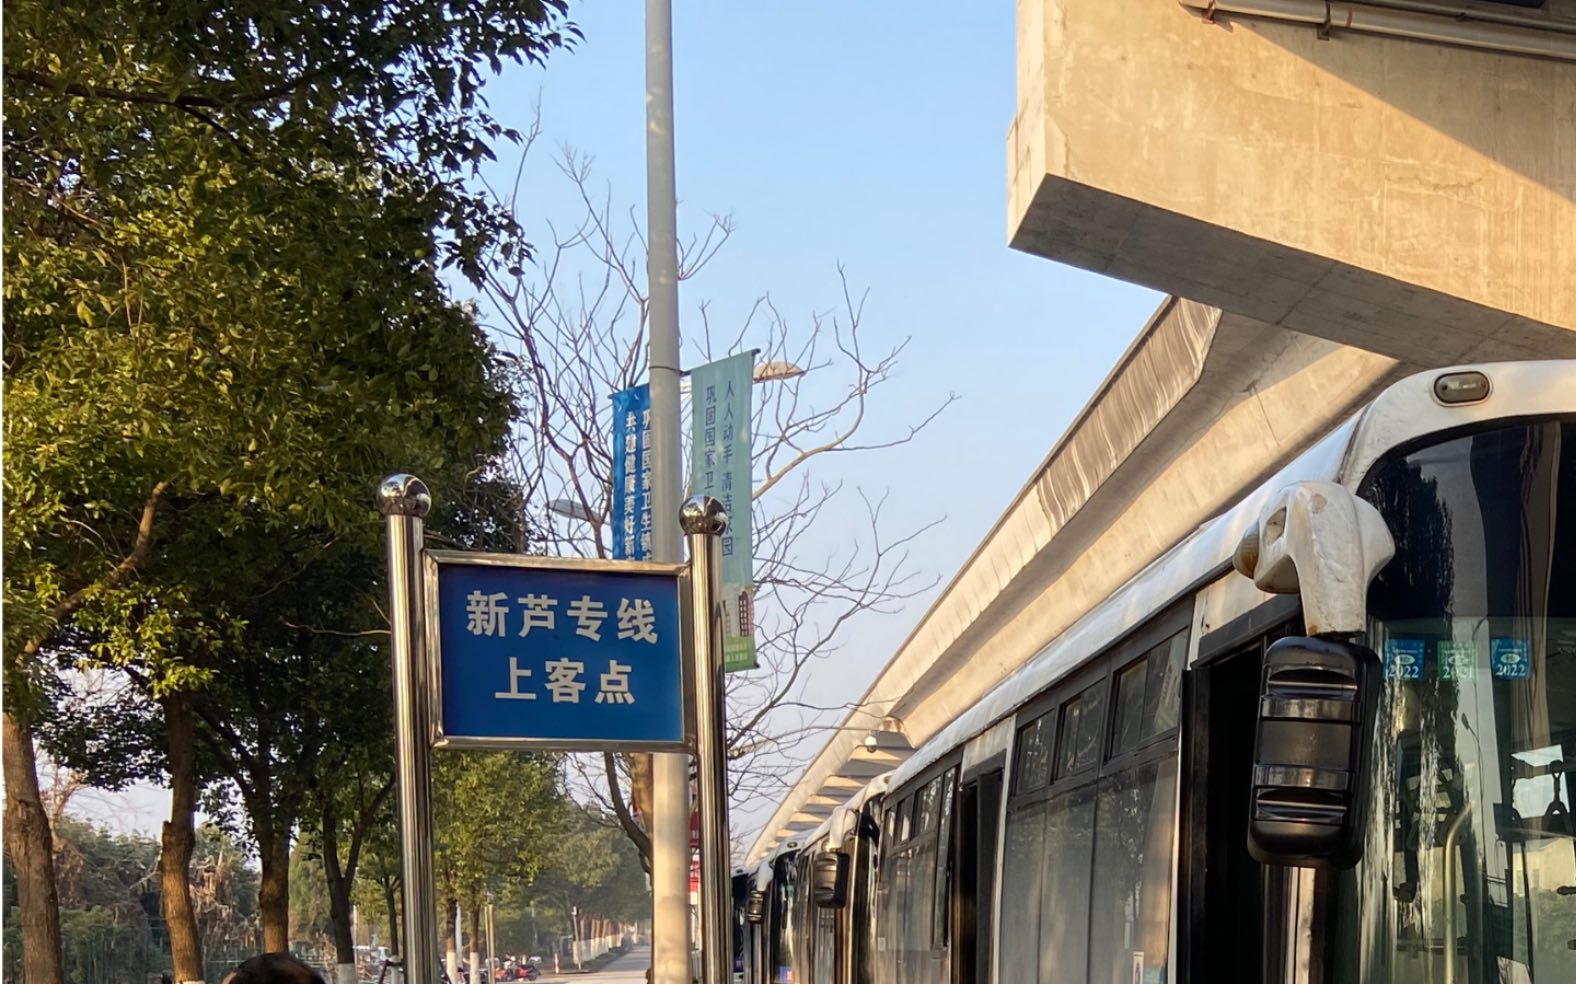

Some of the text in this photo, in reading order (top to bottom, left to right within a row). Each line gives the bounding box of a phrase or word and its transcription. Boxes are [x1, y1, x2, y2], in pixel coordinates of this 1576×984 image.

[704, 385, 718, 496] 巩固国家卫
[722, 380, 735, 465] 人人动手
[466, 590, 659, 644] 新芦专线
[495, 657, 636, 705] 上客点
